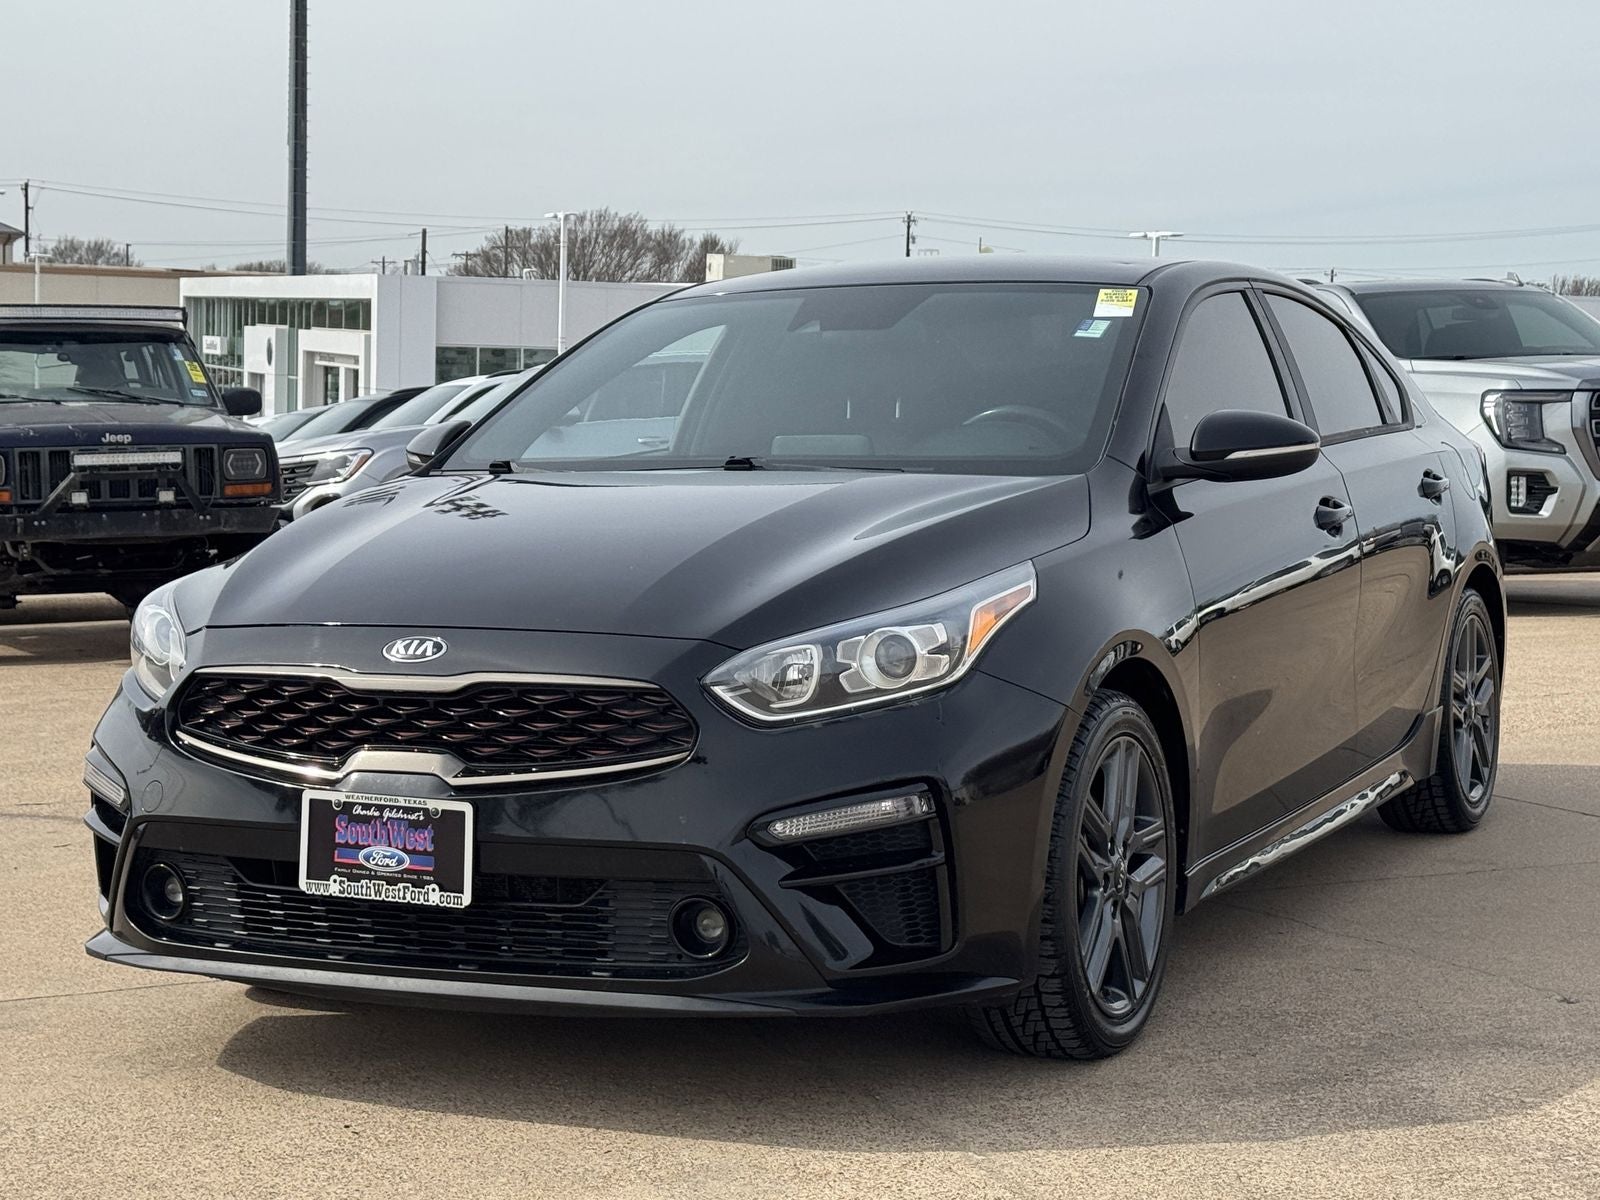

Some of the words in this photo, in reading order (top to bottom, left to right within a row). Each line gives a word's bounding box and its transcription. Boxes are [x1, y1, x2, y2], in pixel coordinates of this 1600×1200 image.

[101, 432, 132, 444] Jeep
[390, 639, 434, 657] KIA
[404, 798, 428, 806] TEXAS
[352, 804, 381, 817] Charlie
[382, 807, 425, 823] Gilchrist's
[335, 814, 434, 851] SouthWest
[369, 850, 399, 867] Ford
[305, 880, 463, 906] www.SouthWestFord.com
